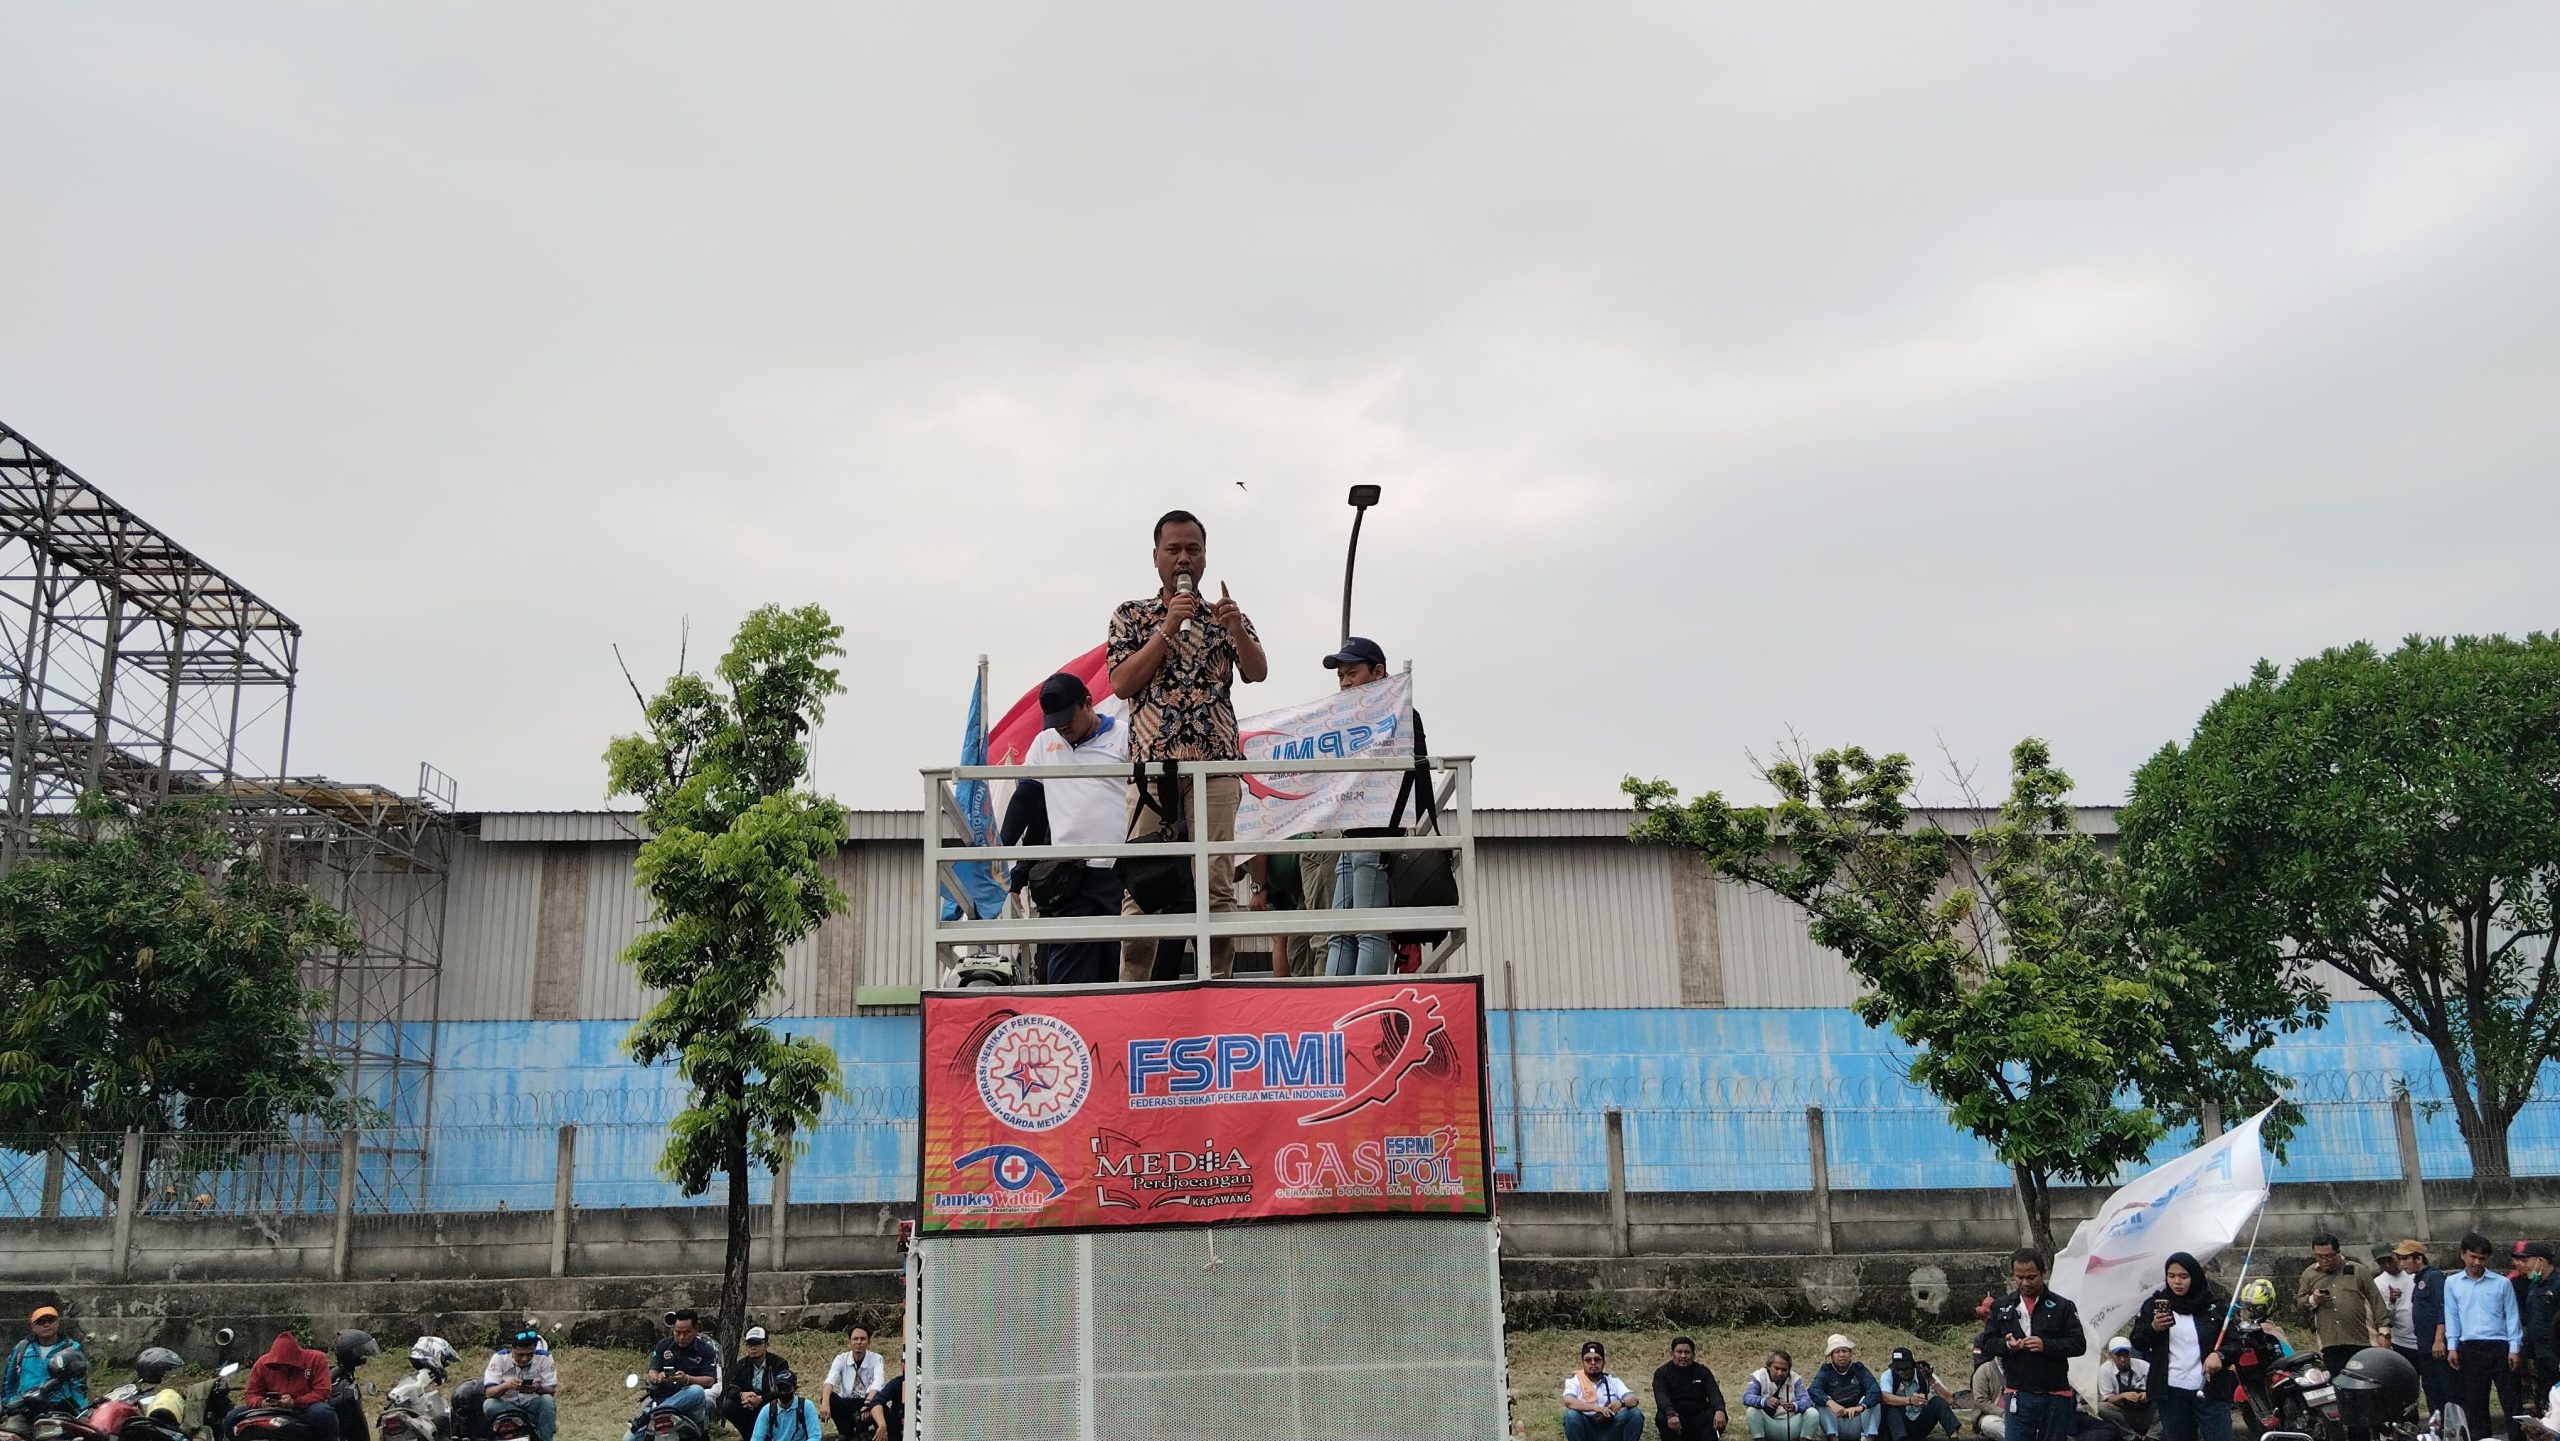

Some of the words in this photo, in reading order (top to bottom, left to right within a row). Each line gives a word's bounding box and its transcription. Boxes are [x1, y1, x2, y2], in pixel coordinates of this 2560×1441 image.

[1010, 1017, 1057, 1029] PEKERJA
[980, 1024, 1010, 1063] SERIKAT
[1056, 1024, 1084, 1053] METAL
[1129, 1031, 1345, 1096] FSPMI
[979, 1063, 1003, 1114] FEDERASI
[1068, 1053, 1090, 1109] INDONESIA
[1130, 1097, 1176, 1108] FEDERASI
[1178, 1093, 1216, 1105] SERIKAT
[1217, 1091, 1259, 1102] PEKERJA
[1260, 1090, 1291, 1101] METAL
[1292, 1089, 1345, 1099] INDONESIA
[1002, 1111, 1035, 1129] GARDA
[1036, 1112, 1068, 1129] METAL
[1384, 1136, 1434, 1156] FSPMI
[1275, 1141, 1383, 1189] GAS
[1386, 1157, 1463, 1187] POL
[932, 1191, 993, 1207] Jamkes
[994, 1190, 1045, 1207] Watch
[1191, 1194, 1252, 1208] KARAWANG
[1275, 1188, 1333, 1198] GERAKAN
[1337, 1187, 1382, 1197] SOSIAL
[1387, 1187, 1412, 1196] DAN
[1416, 1185, 1465, 1196] POLITIK
